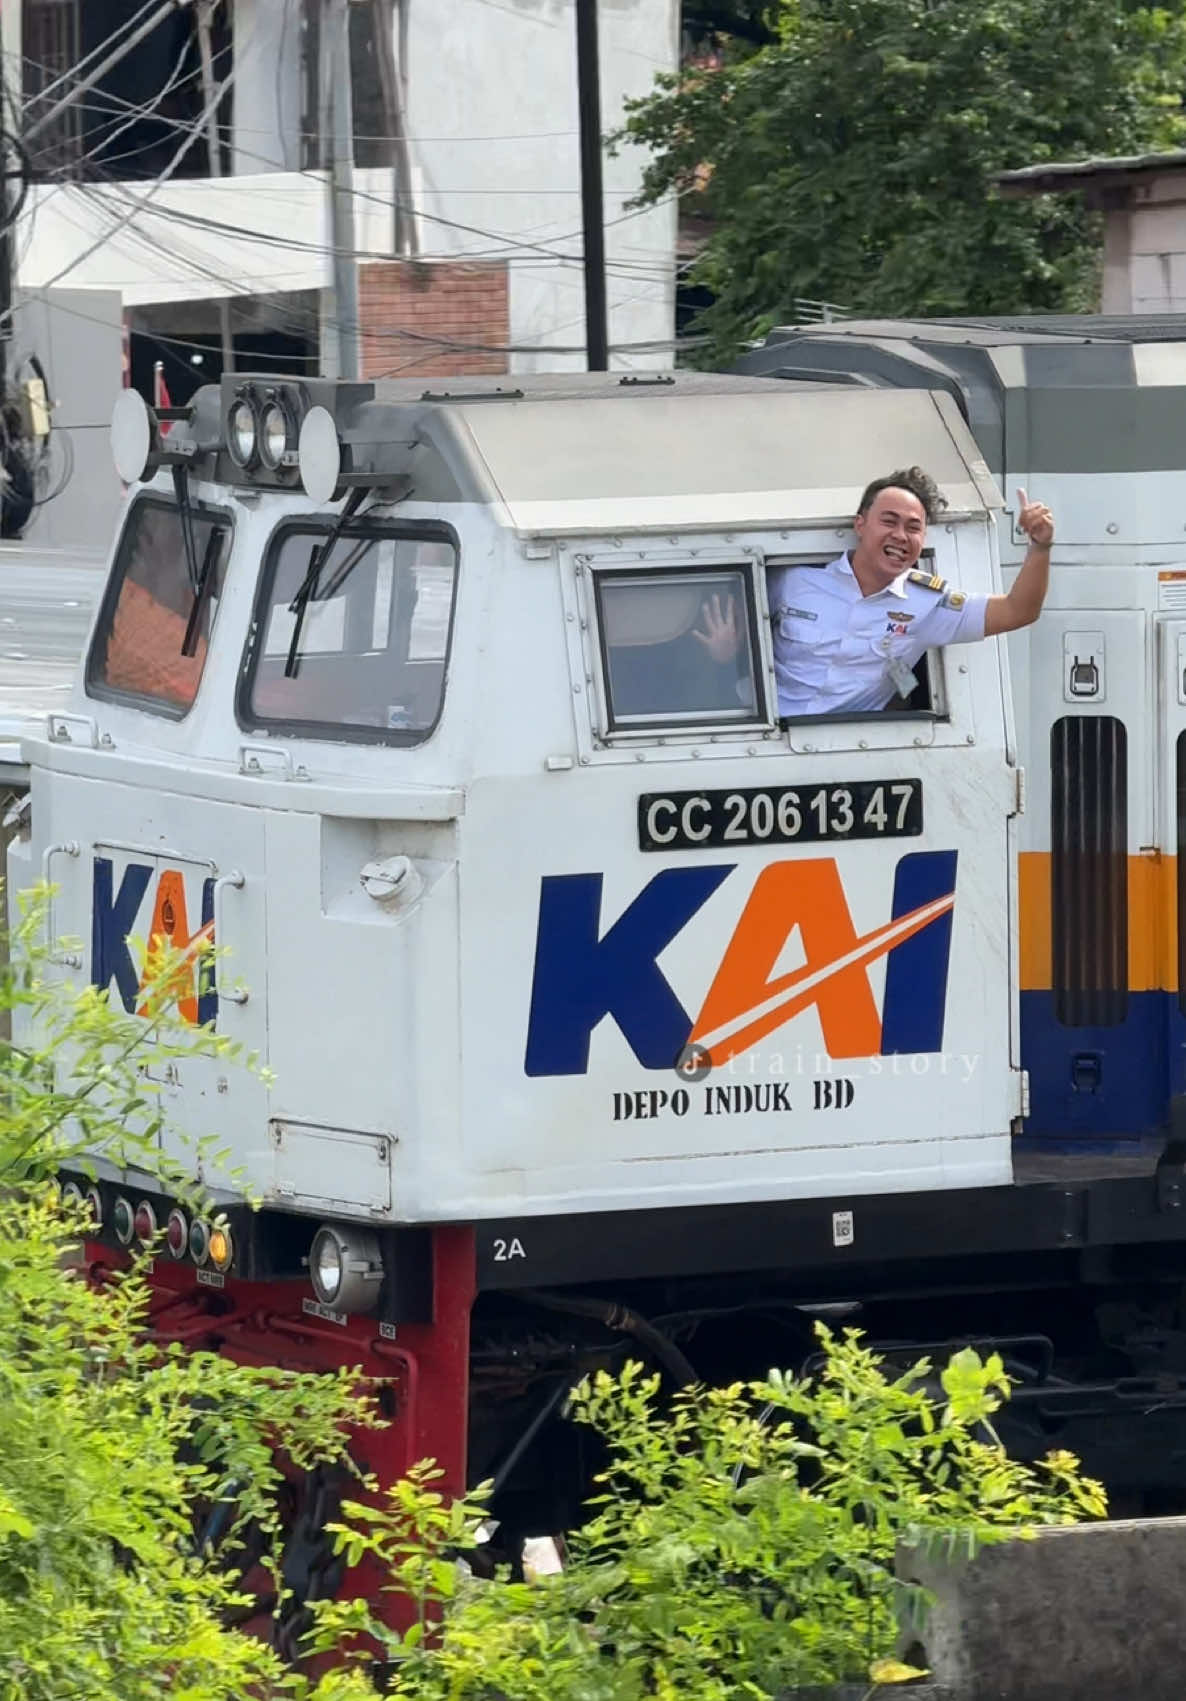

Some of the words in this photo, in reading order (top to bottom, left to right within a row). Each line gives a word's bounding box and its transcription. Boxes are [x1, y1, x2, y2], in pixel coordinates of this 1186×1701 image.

[886, 622, 908, 634] KAI
[647, 797, 712, 843] CC
[723, 792, 801, 840] 206
[810, 789, 854, 834] 13
[863, 785, 913, 831] 47
[525, 849, 958, 1077] KAI
[613, 1089, 690, 1120] DEPO
[704, 1082, 793, 1115] INDUK
[813, 1079, 855, 1110] BD
[493, 1238, 527, 1261] 2A
